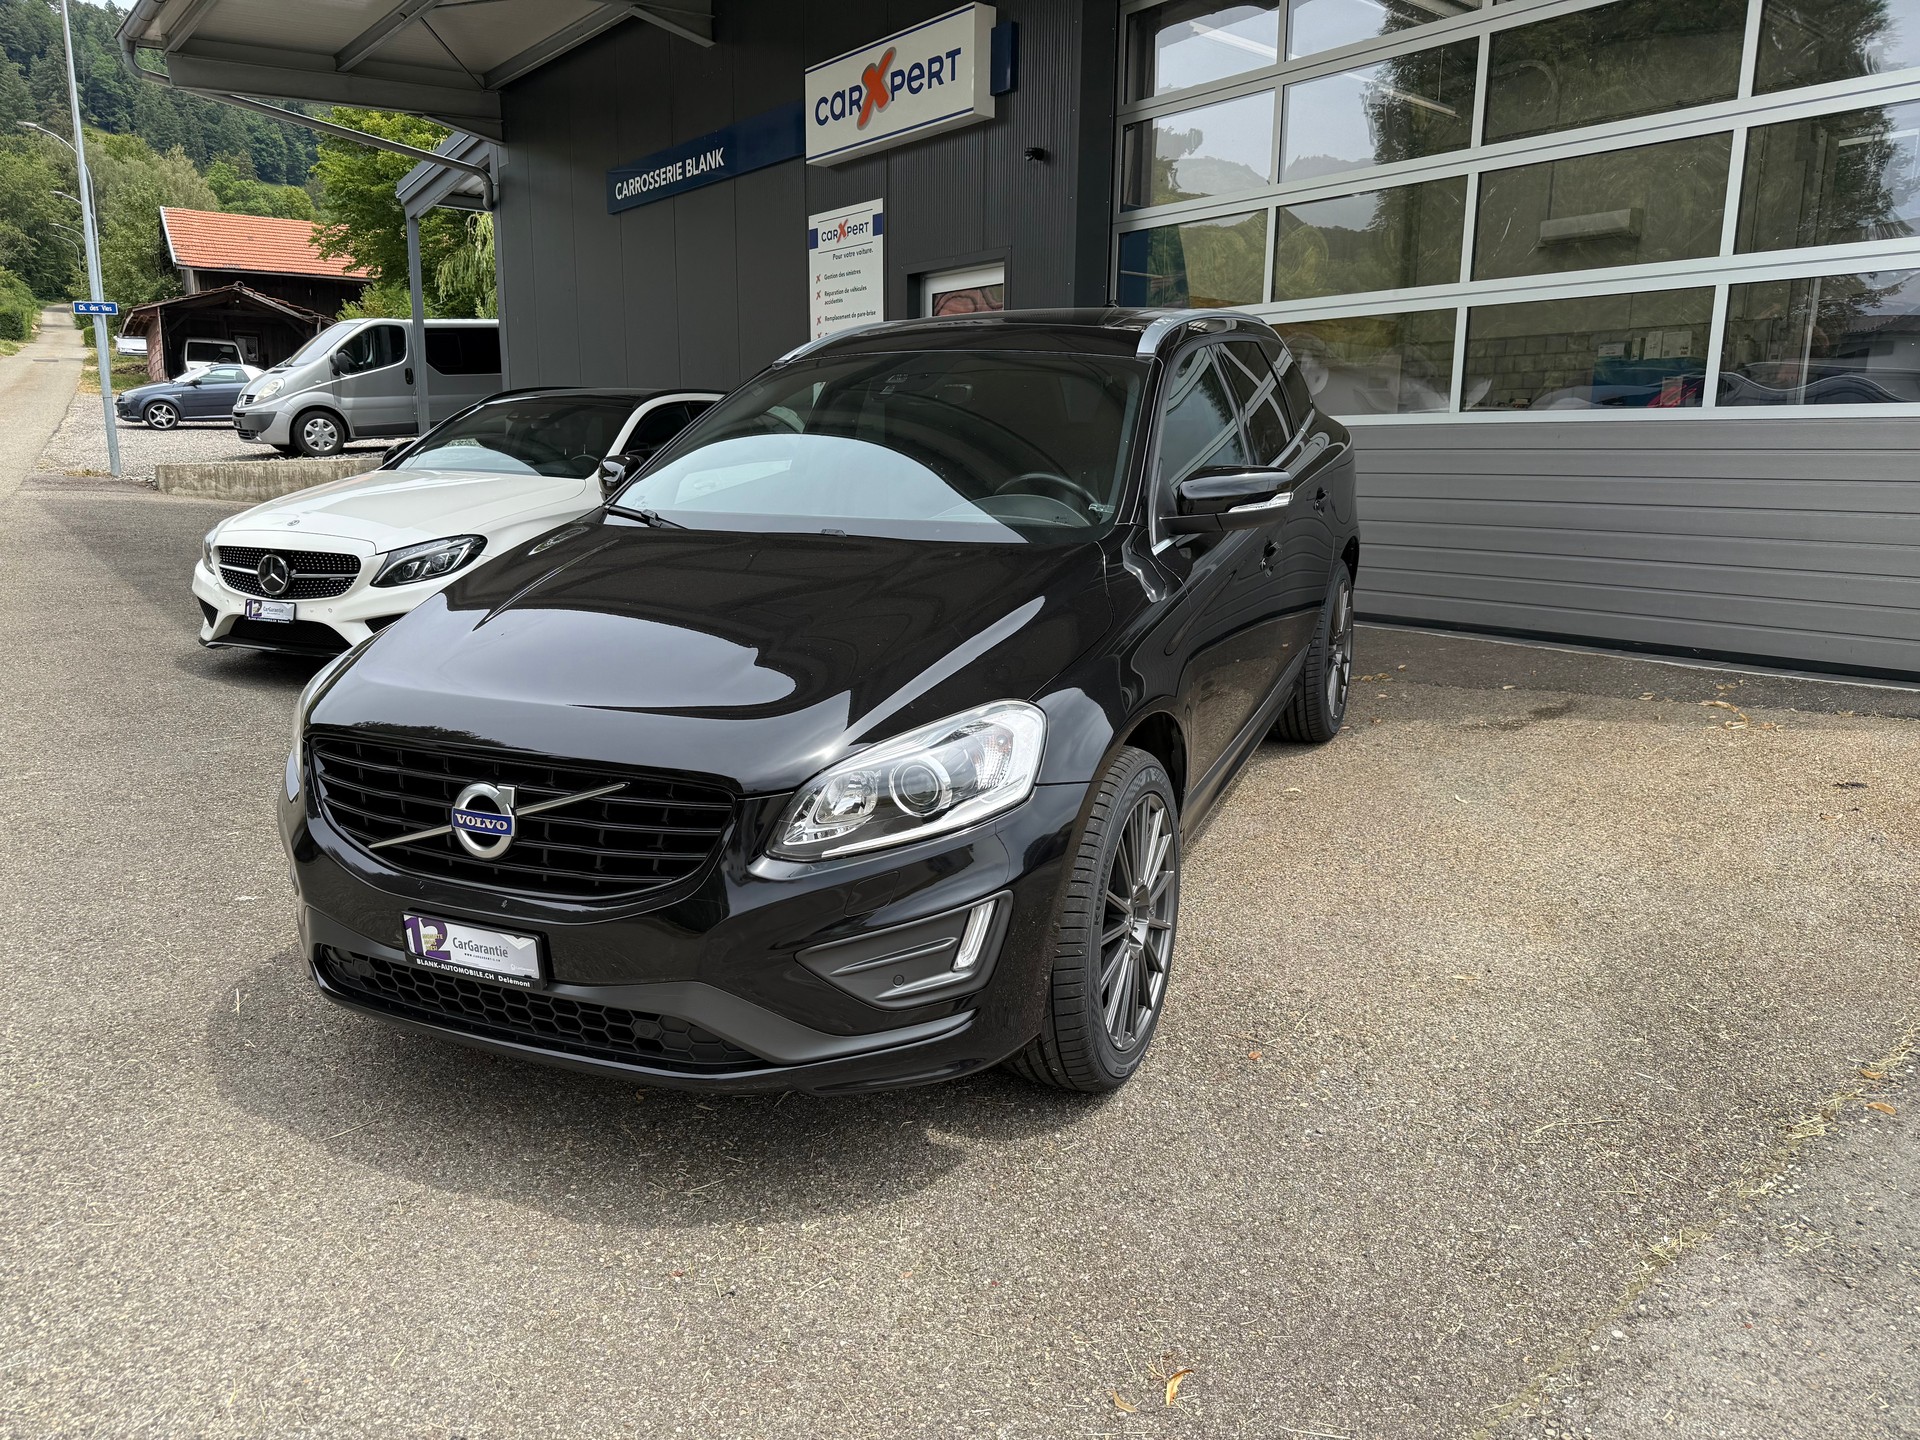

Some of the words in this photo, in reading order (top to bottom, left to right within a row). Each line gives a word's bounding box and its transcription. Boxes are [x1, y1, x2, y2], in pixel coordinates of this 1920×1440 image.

[615, 161, 682, 200] CARROSSERIE
[686, 147, 724, 176] BLANK
[824, 313, 850, 322] Remplacement
[455, 813, 508, 831] VOLVO
[404, 915, 451, 961] 12
[452, 936, 509, 958] CarGarantie
